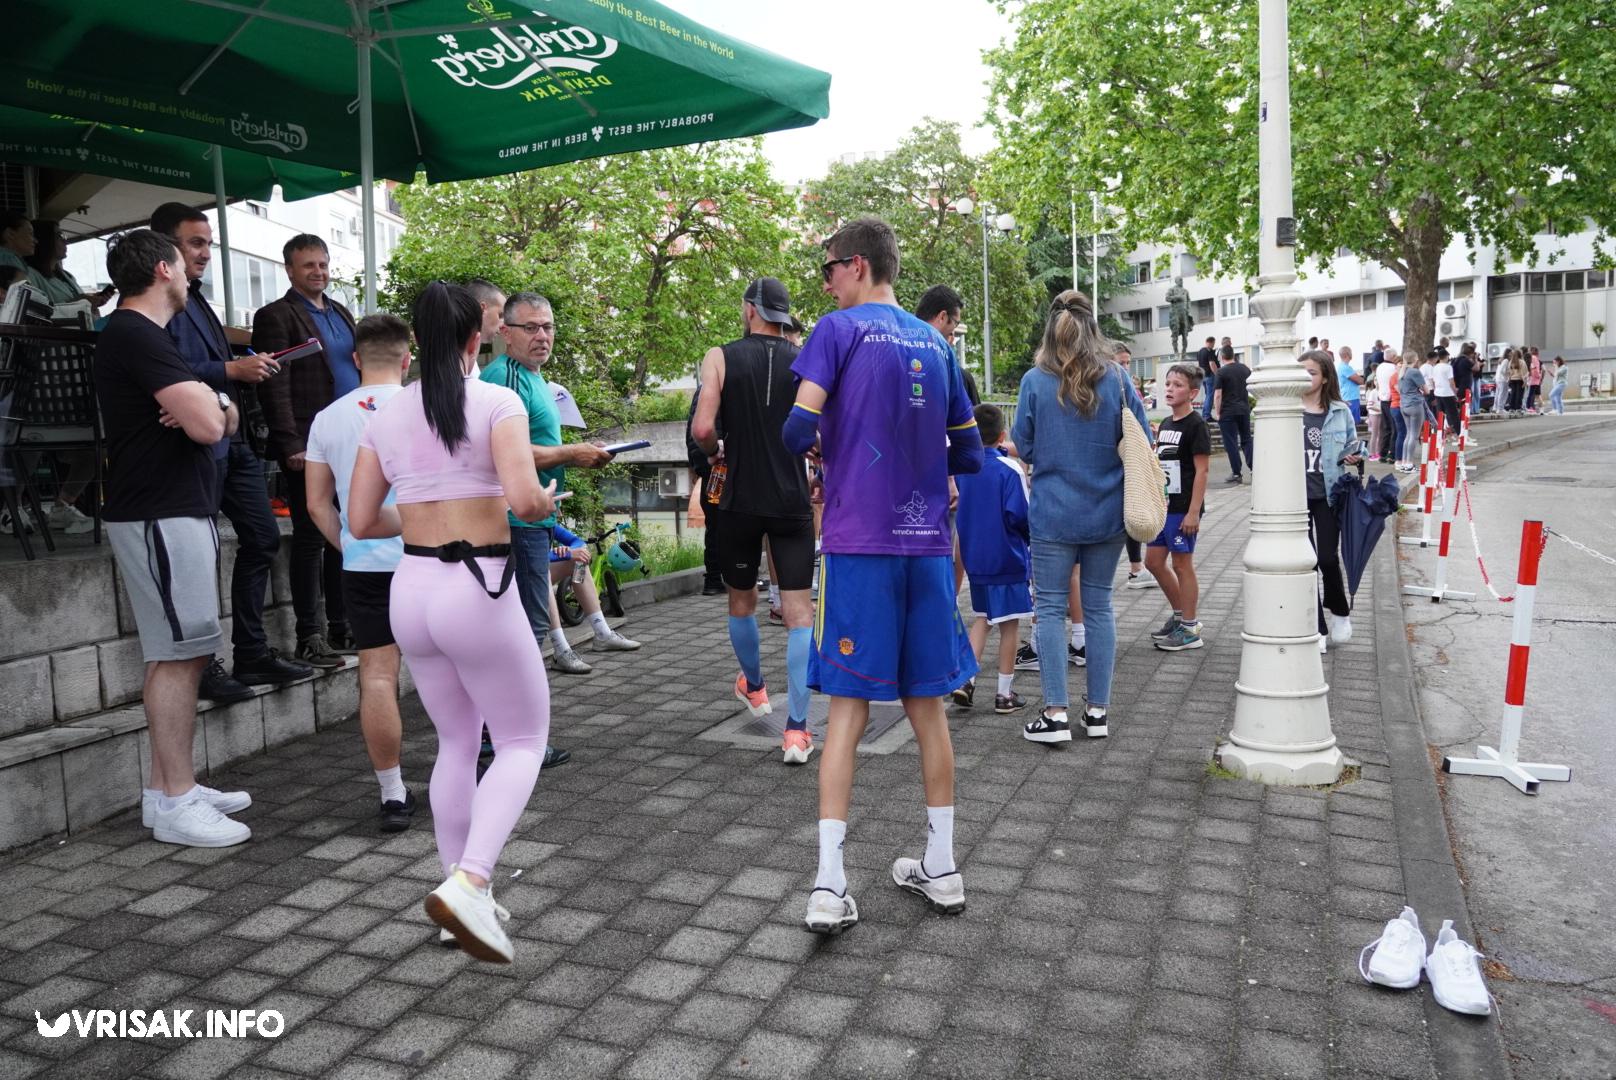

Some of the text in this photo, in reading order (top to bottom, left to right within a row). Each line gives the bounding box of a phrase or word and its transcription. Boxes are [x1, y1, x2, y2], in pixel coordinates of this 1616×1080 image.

[617, 4, 633, 18] the
[636, 10, 657, 28] Best
[659, 20, 681, 37] Beer
[683, 29, 692, 41] in
[694, 34, 708, 48] the
[709, 41, 735, 59] World
[639, 479, 659, 492] BUFF
